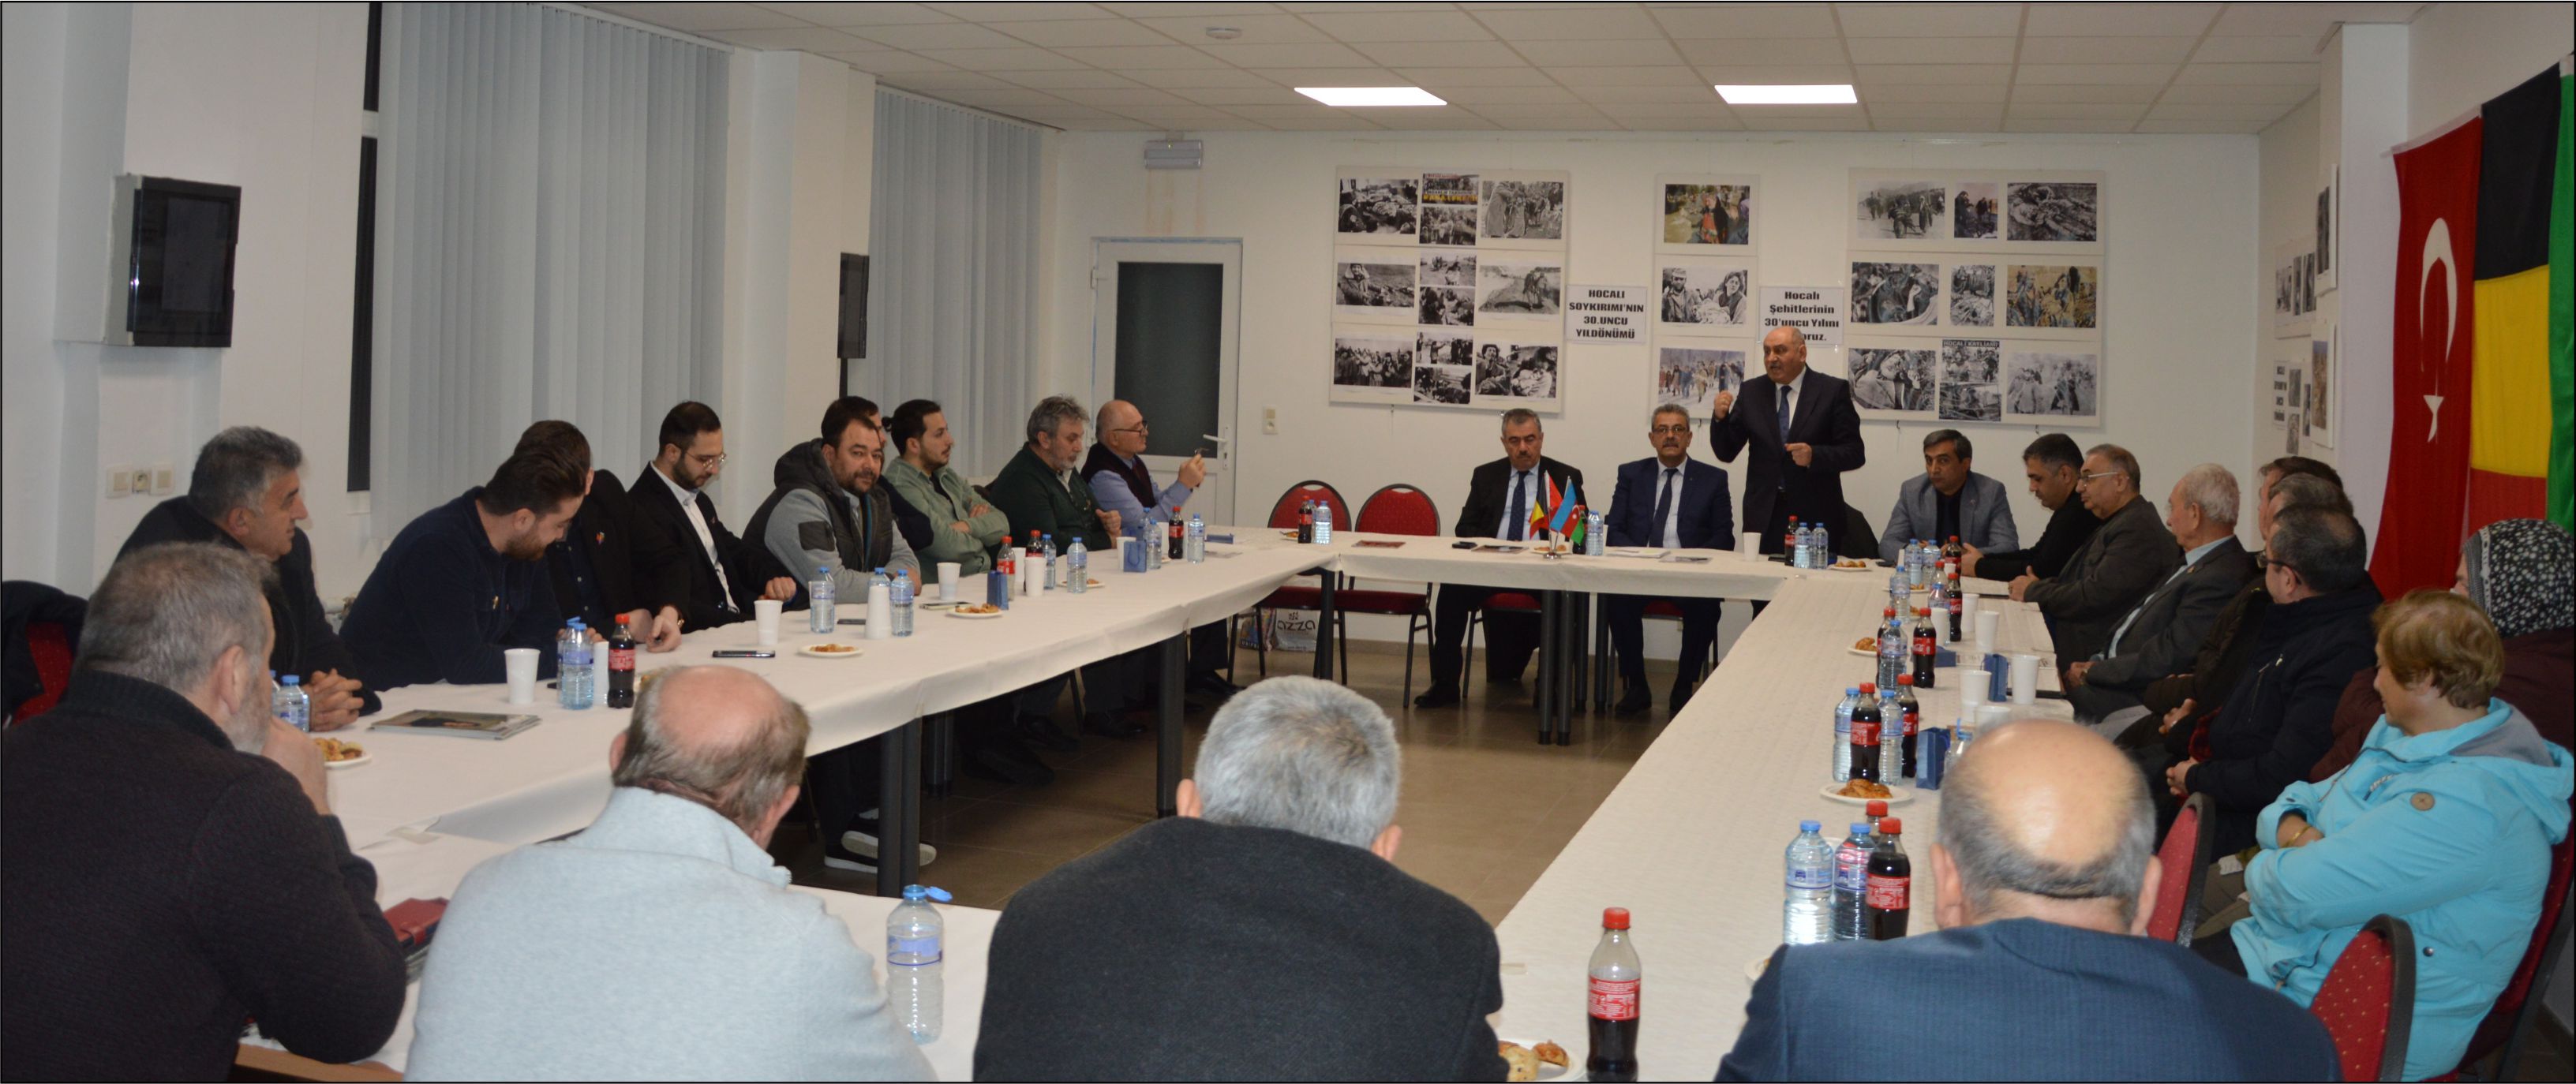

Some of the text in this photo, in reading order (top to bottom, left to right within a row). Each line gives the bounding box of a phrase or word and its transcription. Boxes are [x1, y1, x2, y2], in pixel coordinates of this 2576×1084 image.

[1588, 290, 1625, 298] HOCALI
[1784, 291, 1820, 300] Hocalı
[1569, 302, 1644, 312] SOYKIRIMI'NIN
[1769, 305, 1835, 315] Şehitlerinin
[1583, 316, 1628, 325] 30.UNCU
[1765, 318, 1839, 327] 30'uncu Yılını
[1576, 327, 1635, 338] YILDÖNÜMÜ
